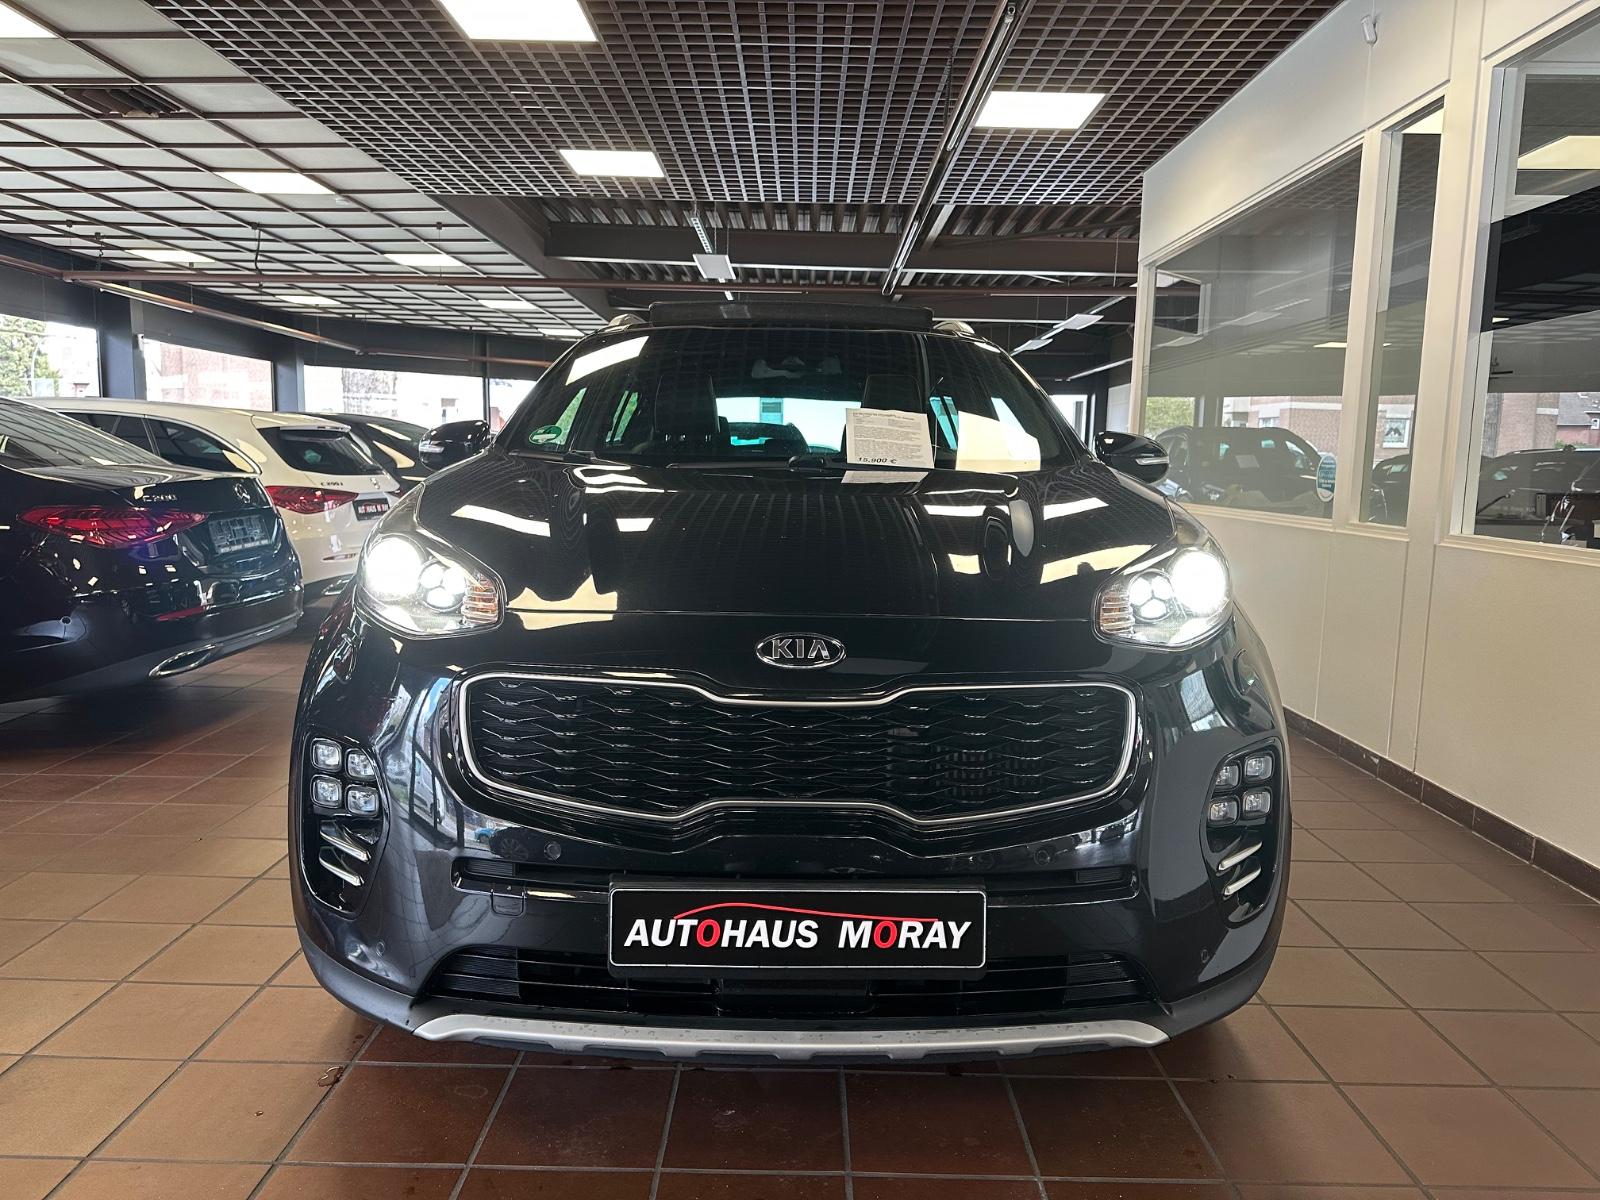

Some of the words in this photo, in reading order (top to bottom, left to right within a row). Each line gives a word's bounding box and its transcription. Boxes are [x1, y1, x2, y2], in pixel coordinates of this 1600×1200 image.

[771, 638, 831, 660] KIA
[624, 918, 819, 949] AUTOHAUS
[838, 919, 972, 949] MORAY
